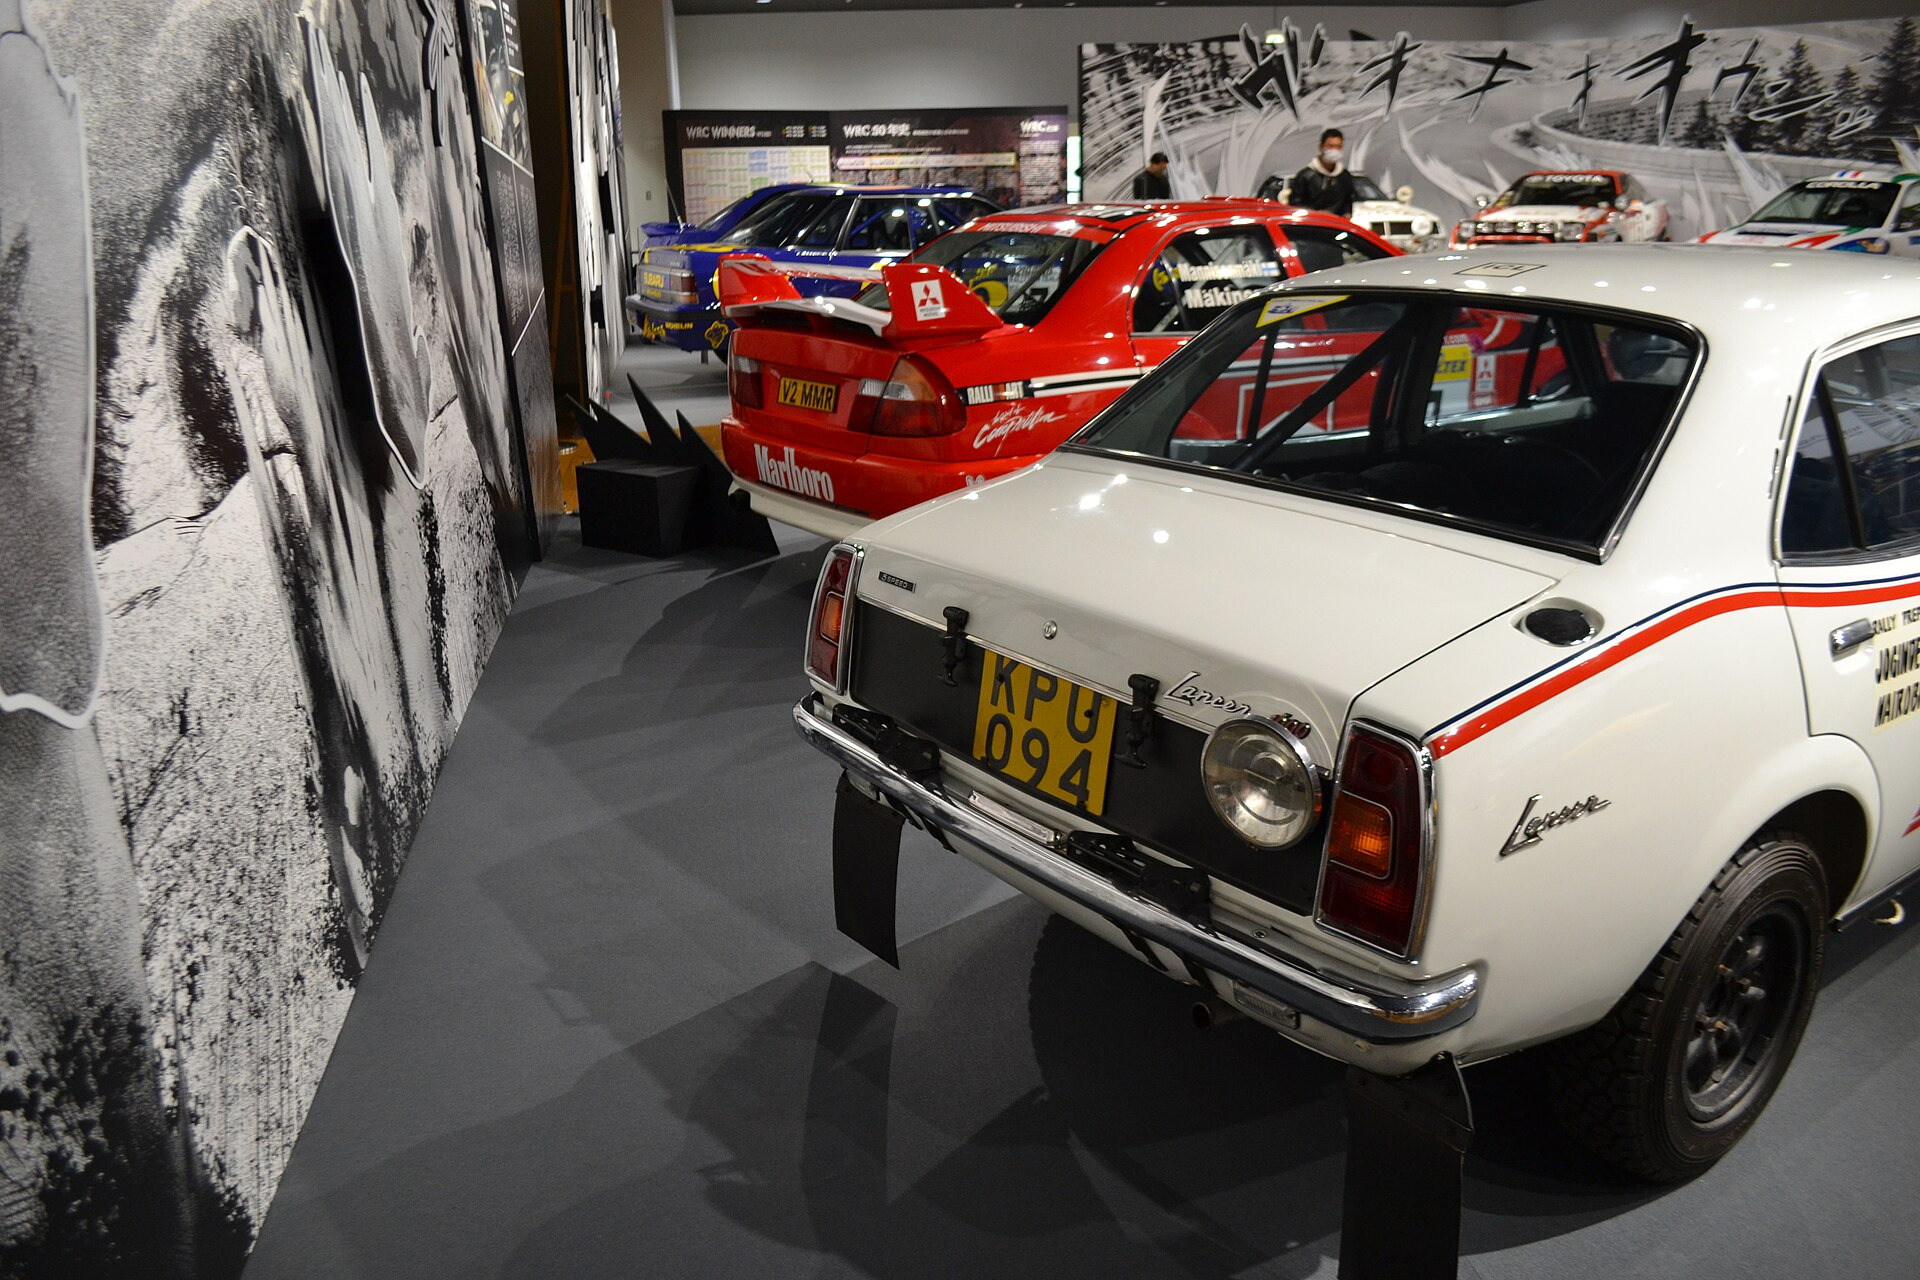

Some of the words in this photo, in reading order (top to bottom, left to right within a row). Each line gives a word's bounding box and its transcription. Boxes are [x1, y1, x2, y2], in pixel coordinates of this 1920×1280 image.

[686, 125, 710, 140] WRC
[711, 125, 756, 140] WINNERS
[843, 125, 871, 139] WRC
[1020, 120, 1047, 133] WRC
[1544, 174, 1605, 184] TOYOTA
[1805, 181, 1880, 190] COROLLA
[1185, 286, 1255, 309] Mäkine
[783, 380, 798, 403] V2
[800, 382, 834, 411] MMR
[753, 443, 835, 502] Marlboro
[991, 653, 1102, 744] KPU
[1162, 671, 1252, 720] Lancer
[985, 713, 1094, 808] 094
